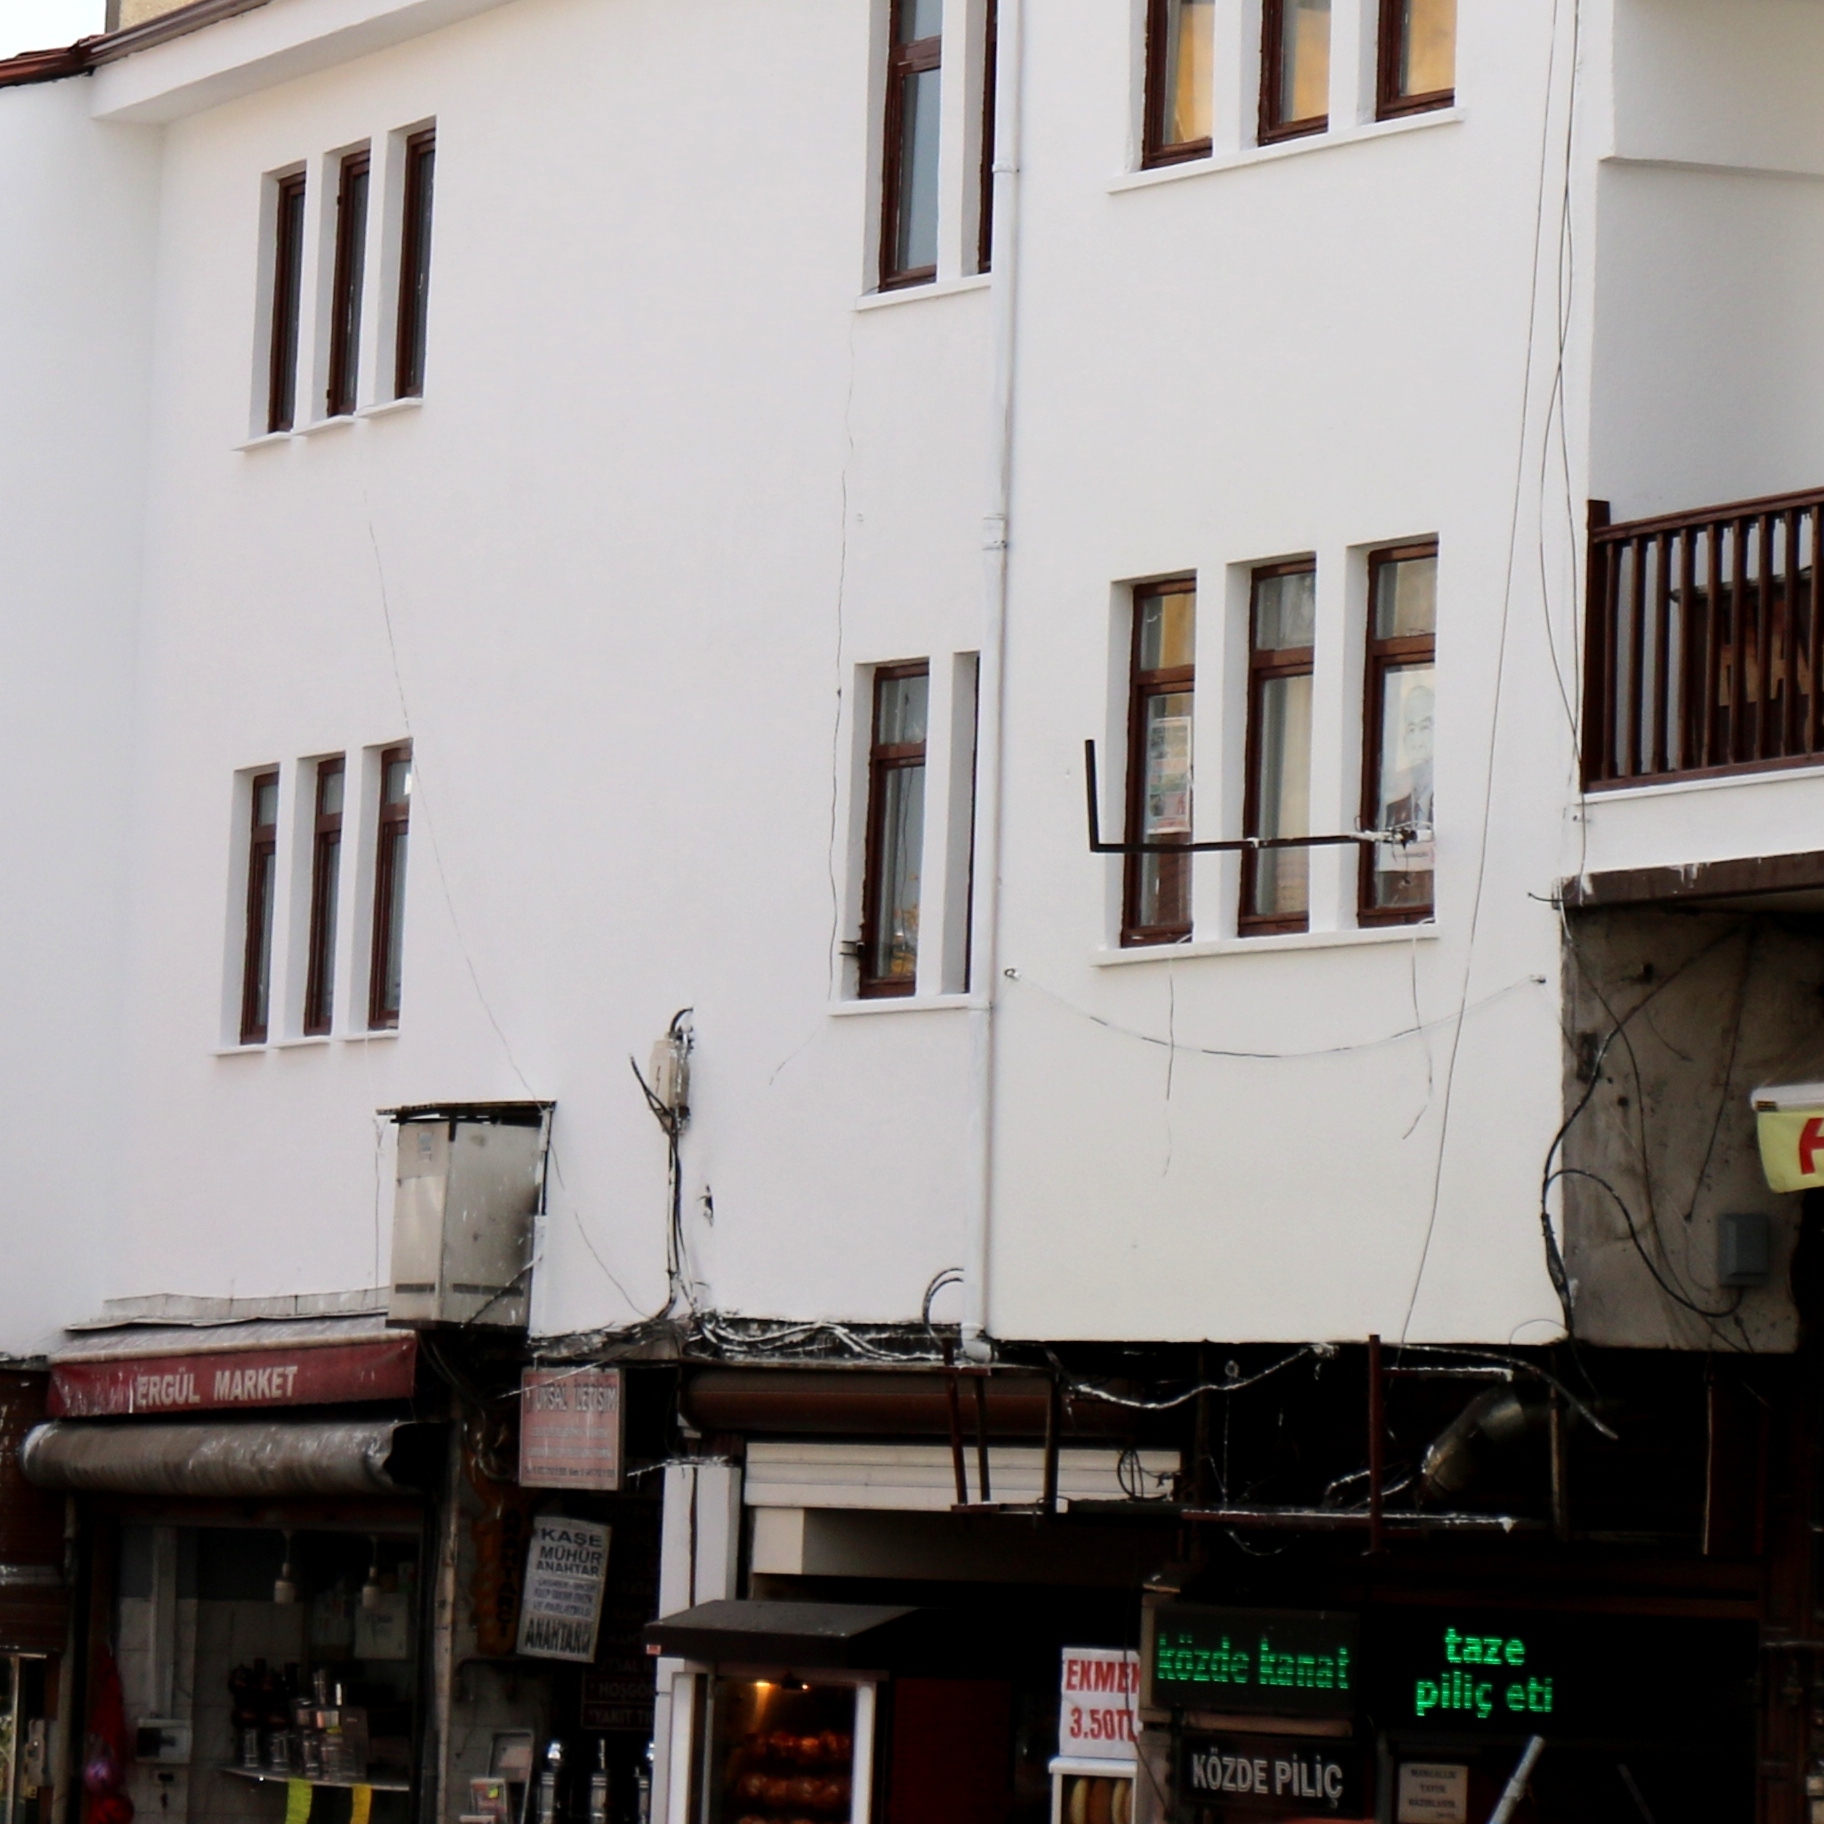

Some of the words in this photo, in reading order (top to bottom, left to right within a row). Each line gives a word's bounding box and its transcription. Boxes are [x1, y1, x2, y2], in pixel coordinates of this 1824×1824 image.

[135, 1367, 200, 1407] ERGÜL
[213, 1366, 298, 1402] MARKET
[538, 1545, 604, 1566] MÜHÜR
[539, 1526, 604, 1549] KAŞE
[535, 1559, 600, 1577] ANAHTAR
[1157, 1633, 1250, 1684] közde
[1258, 1634, 1350, 1690] kanat
[1444, 1627, 1526, 1666] taze
[1415, 1670, 1493, 1718] piliç
[1506, 1676, 1553, 1713] eti
[1192, 1746, 1269, 1794] KÖZDE
[1275, 1753, 1344, 1809] PİLİÇ
